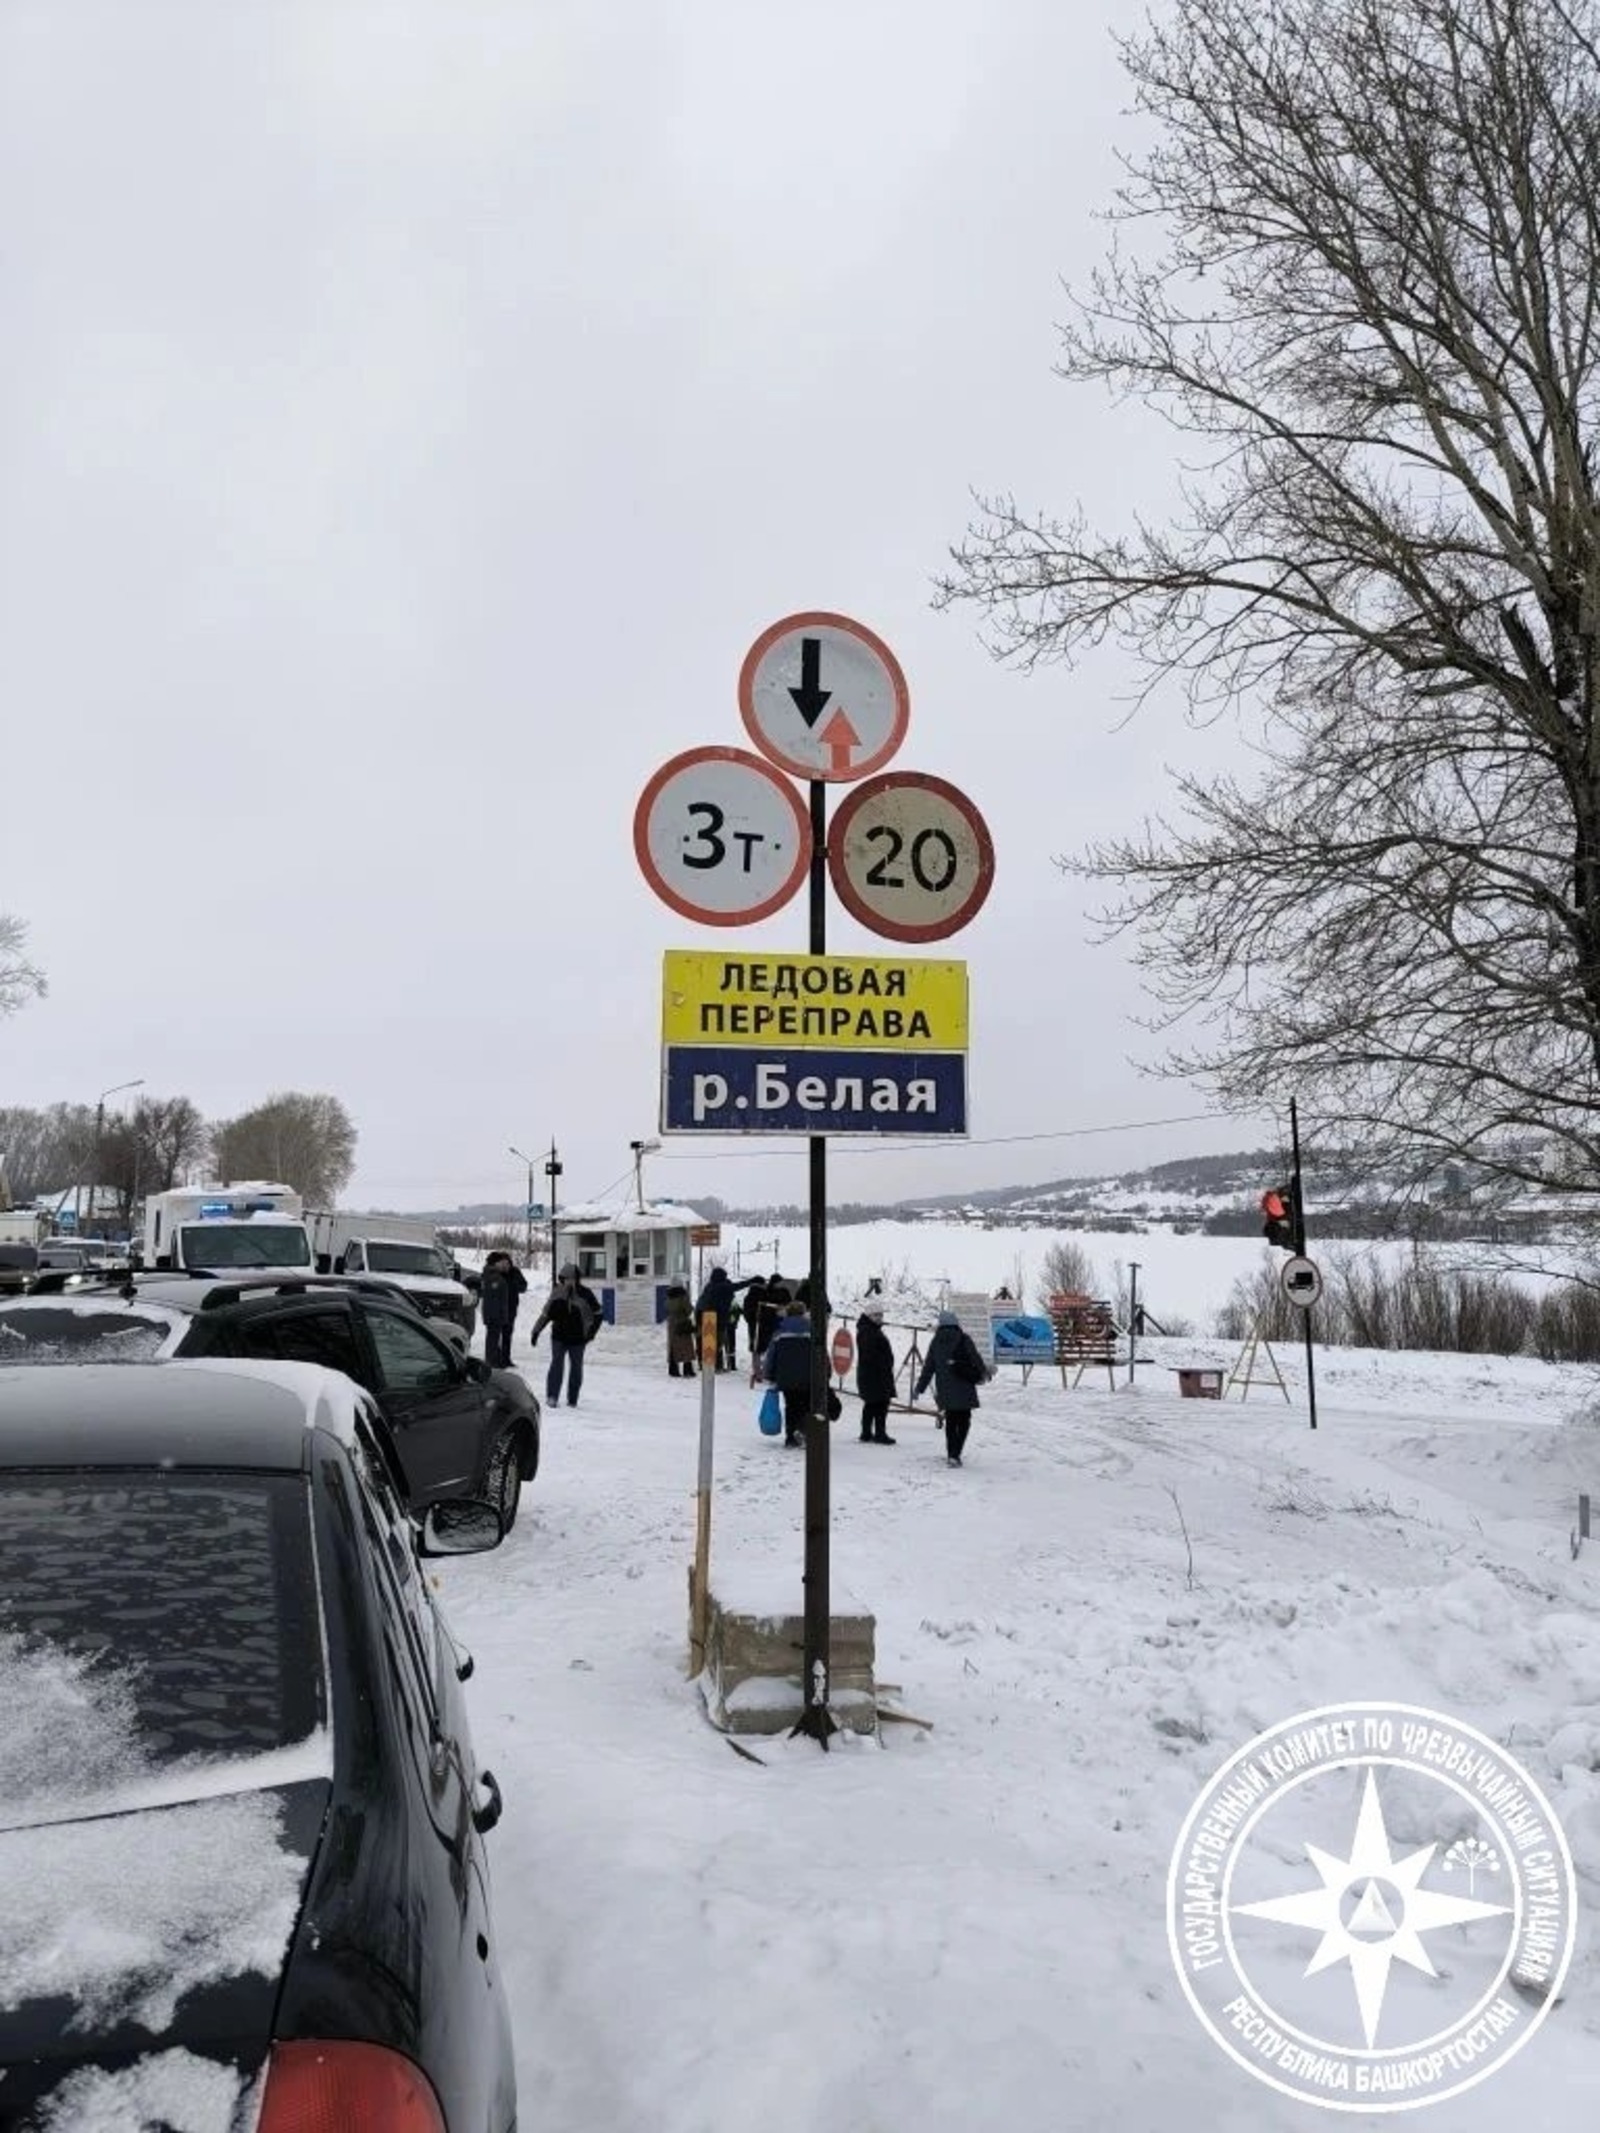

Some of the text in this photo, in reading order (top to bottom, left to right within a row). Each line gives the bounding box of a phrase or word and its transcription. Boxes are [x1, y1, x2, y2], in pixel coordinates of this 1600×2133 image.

[865, 826, 957, 892] 20
[719, 963, 907, 1001] ЛЕДОВАЯ
[700, 1003, 932, 1039] ПЕРЕПРАВА
